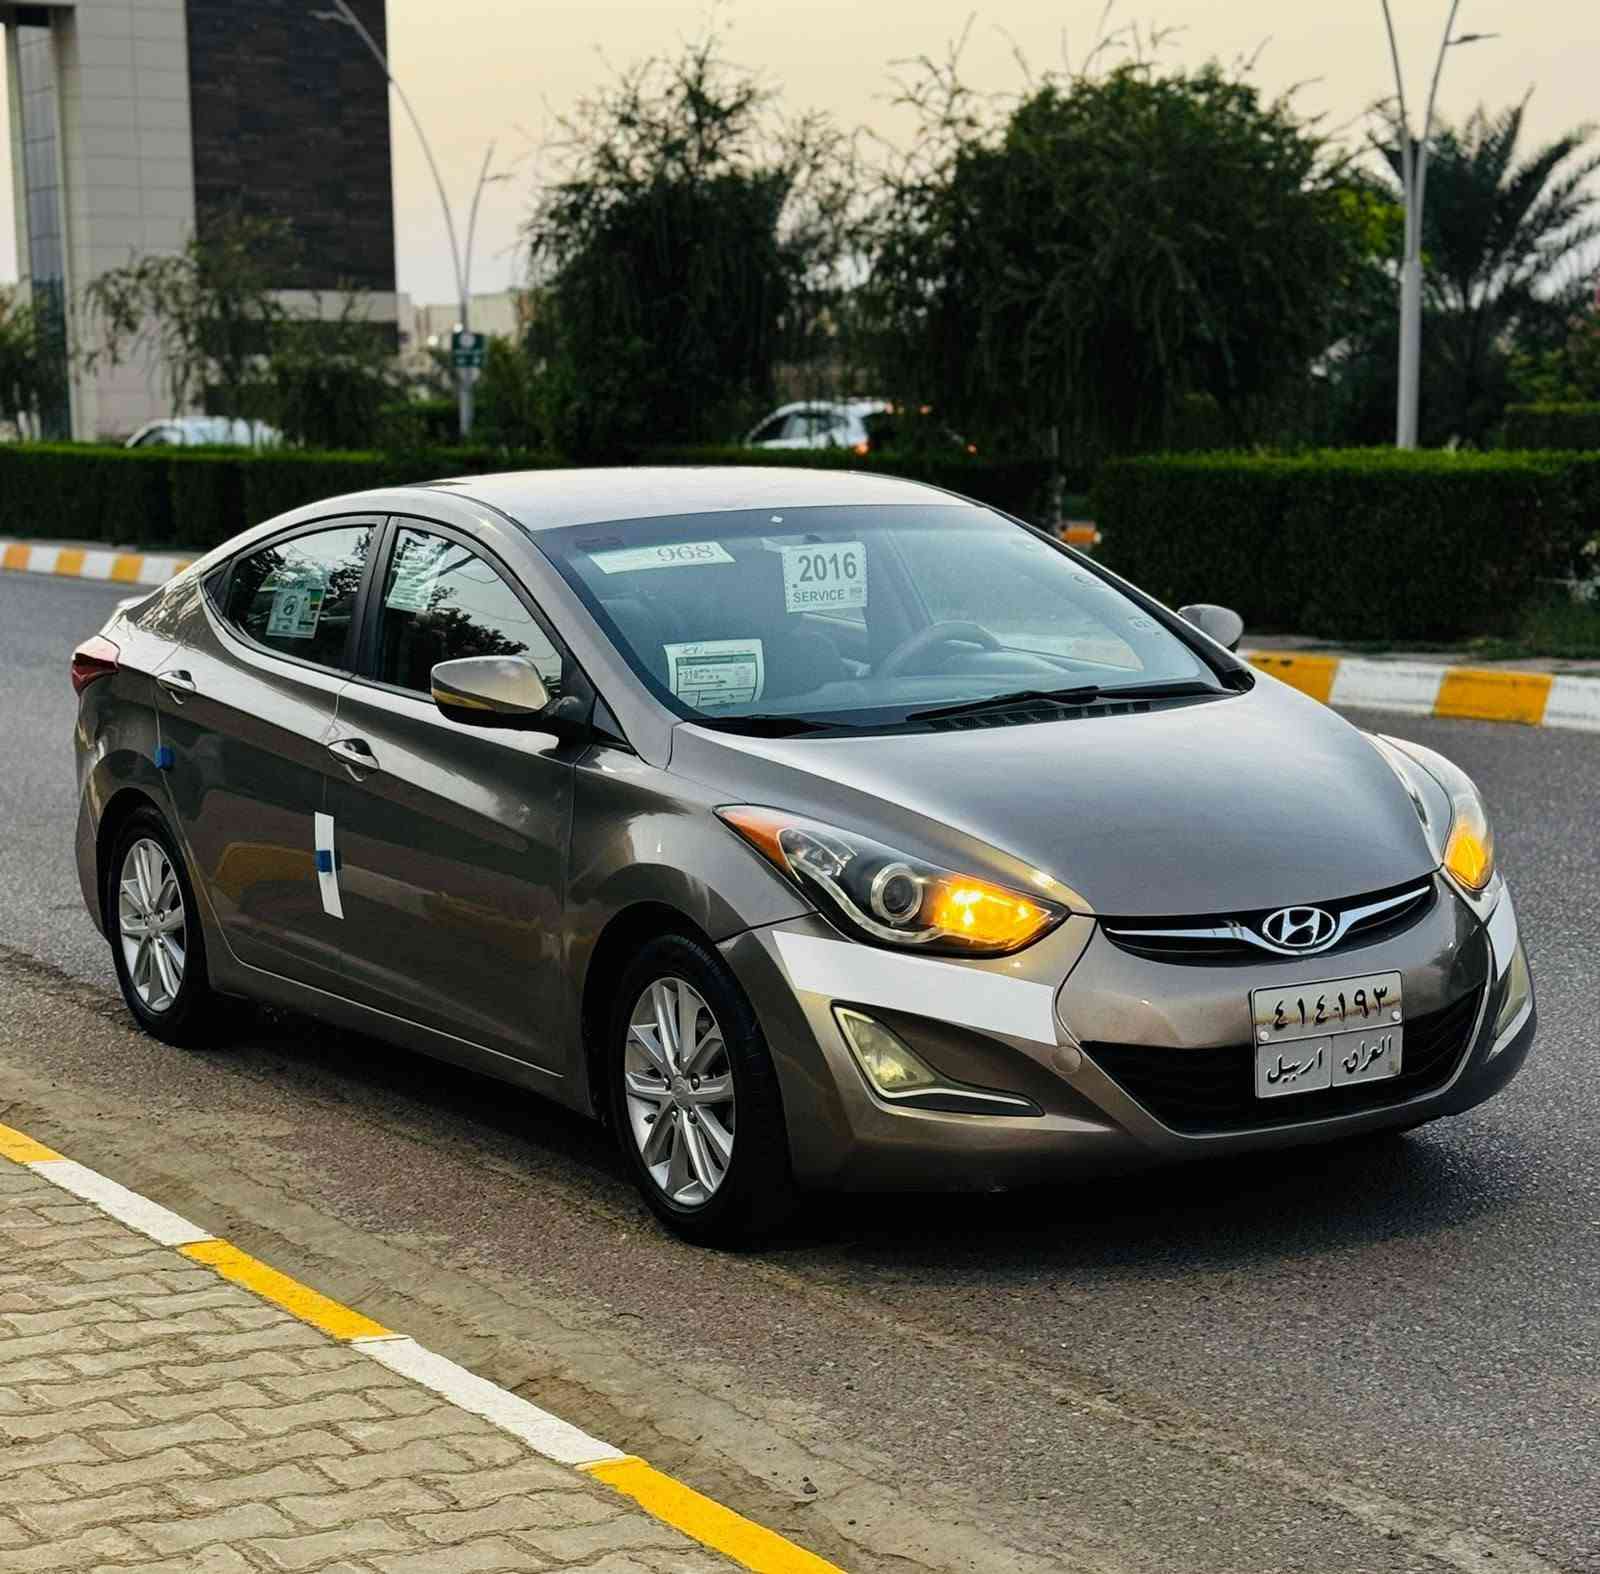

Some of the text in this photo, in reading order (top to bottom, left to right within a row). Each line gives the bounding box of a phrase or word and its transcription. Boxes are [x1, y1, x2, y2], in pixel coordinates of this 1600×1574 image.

[656, 545, 715, 561] 968
[798, 552, 857, 582] 2016
[793, 588, 846, 603] SERVICE
[1342, 1034, 1392, 1074] العراق
